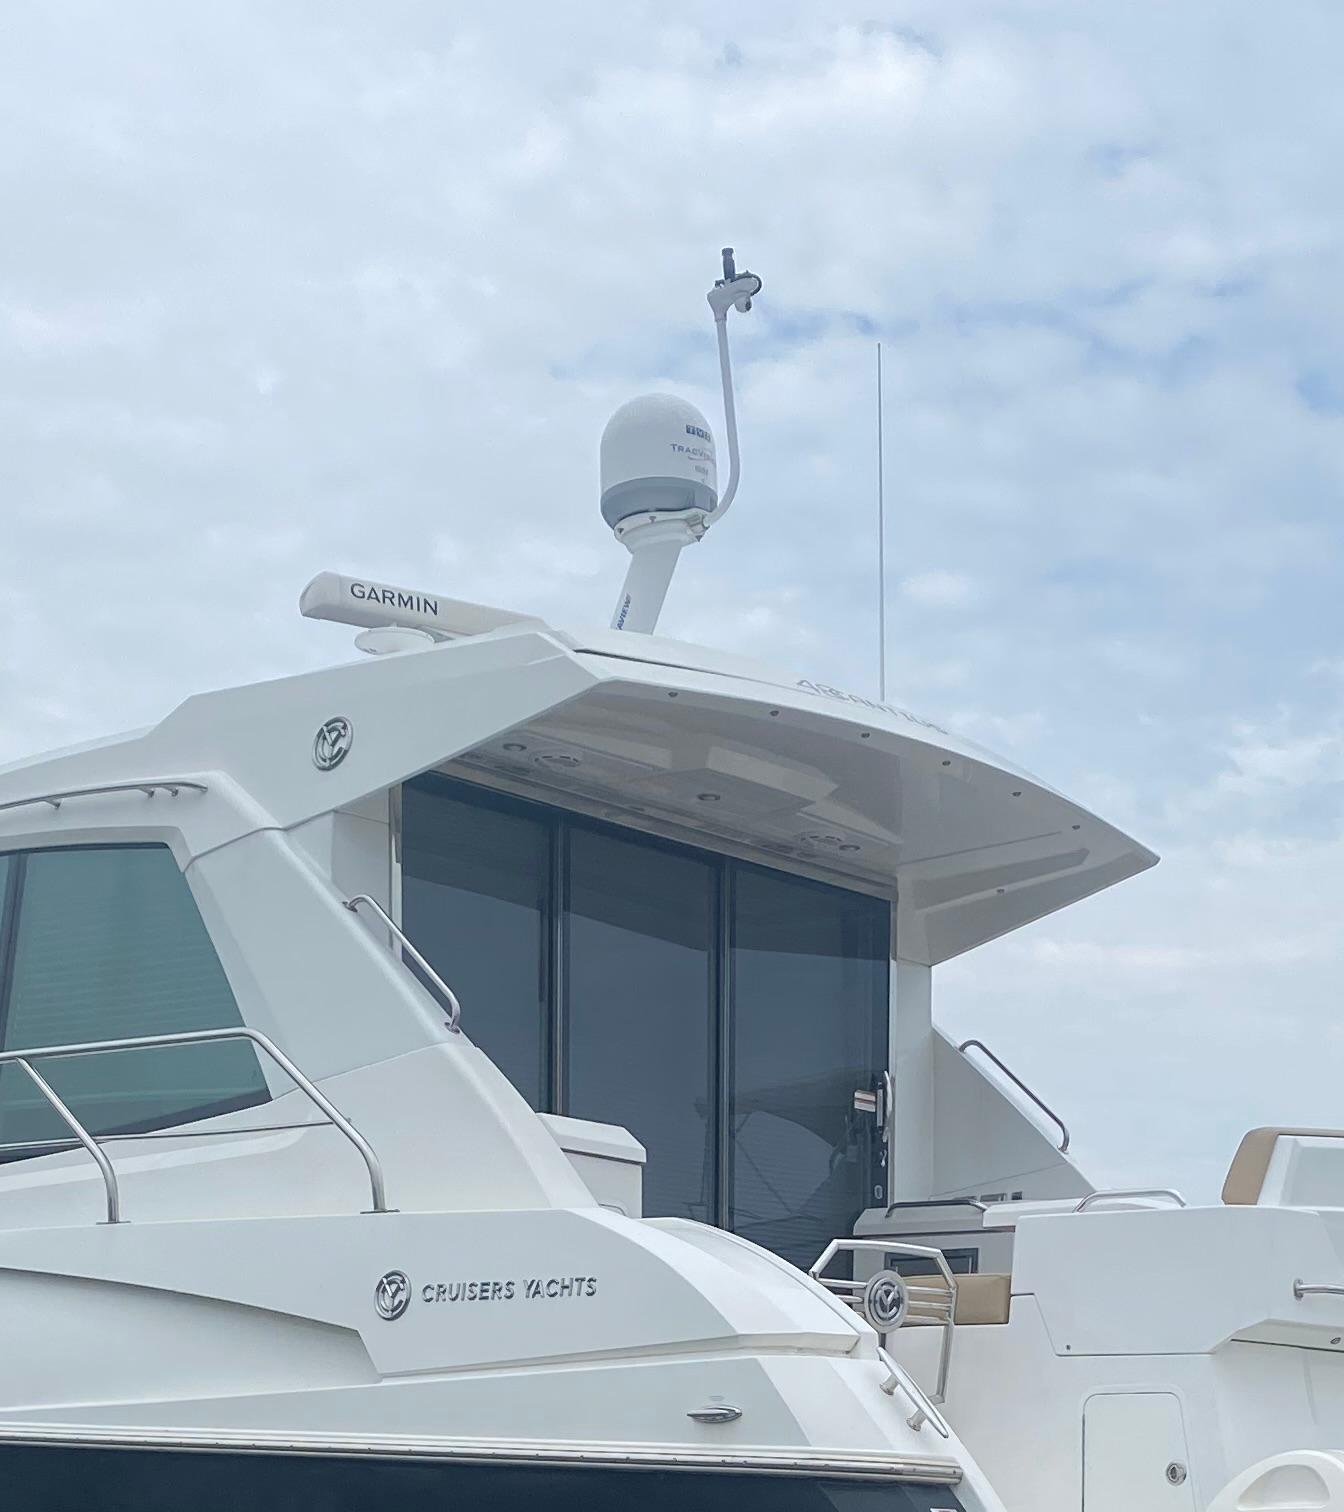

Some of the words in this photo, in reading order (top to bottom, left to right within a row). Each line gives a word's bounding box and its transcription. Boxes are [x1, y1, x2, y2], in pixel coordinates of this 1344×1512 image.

[349, 582, 438, 616] GARMIN
[421, 1279, 516, 1303] CRUISERS
[522, 1276, 598, 1300] YACHTS
